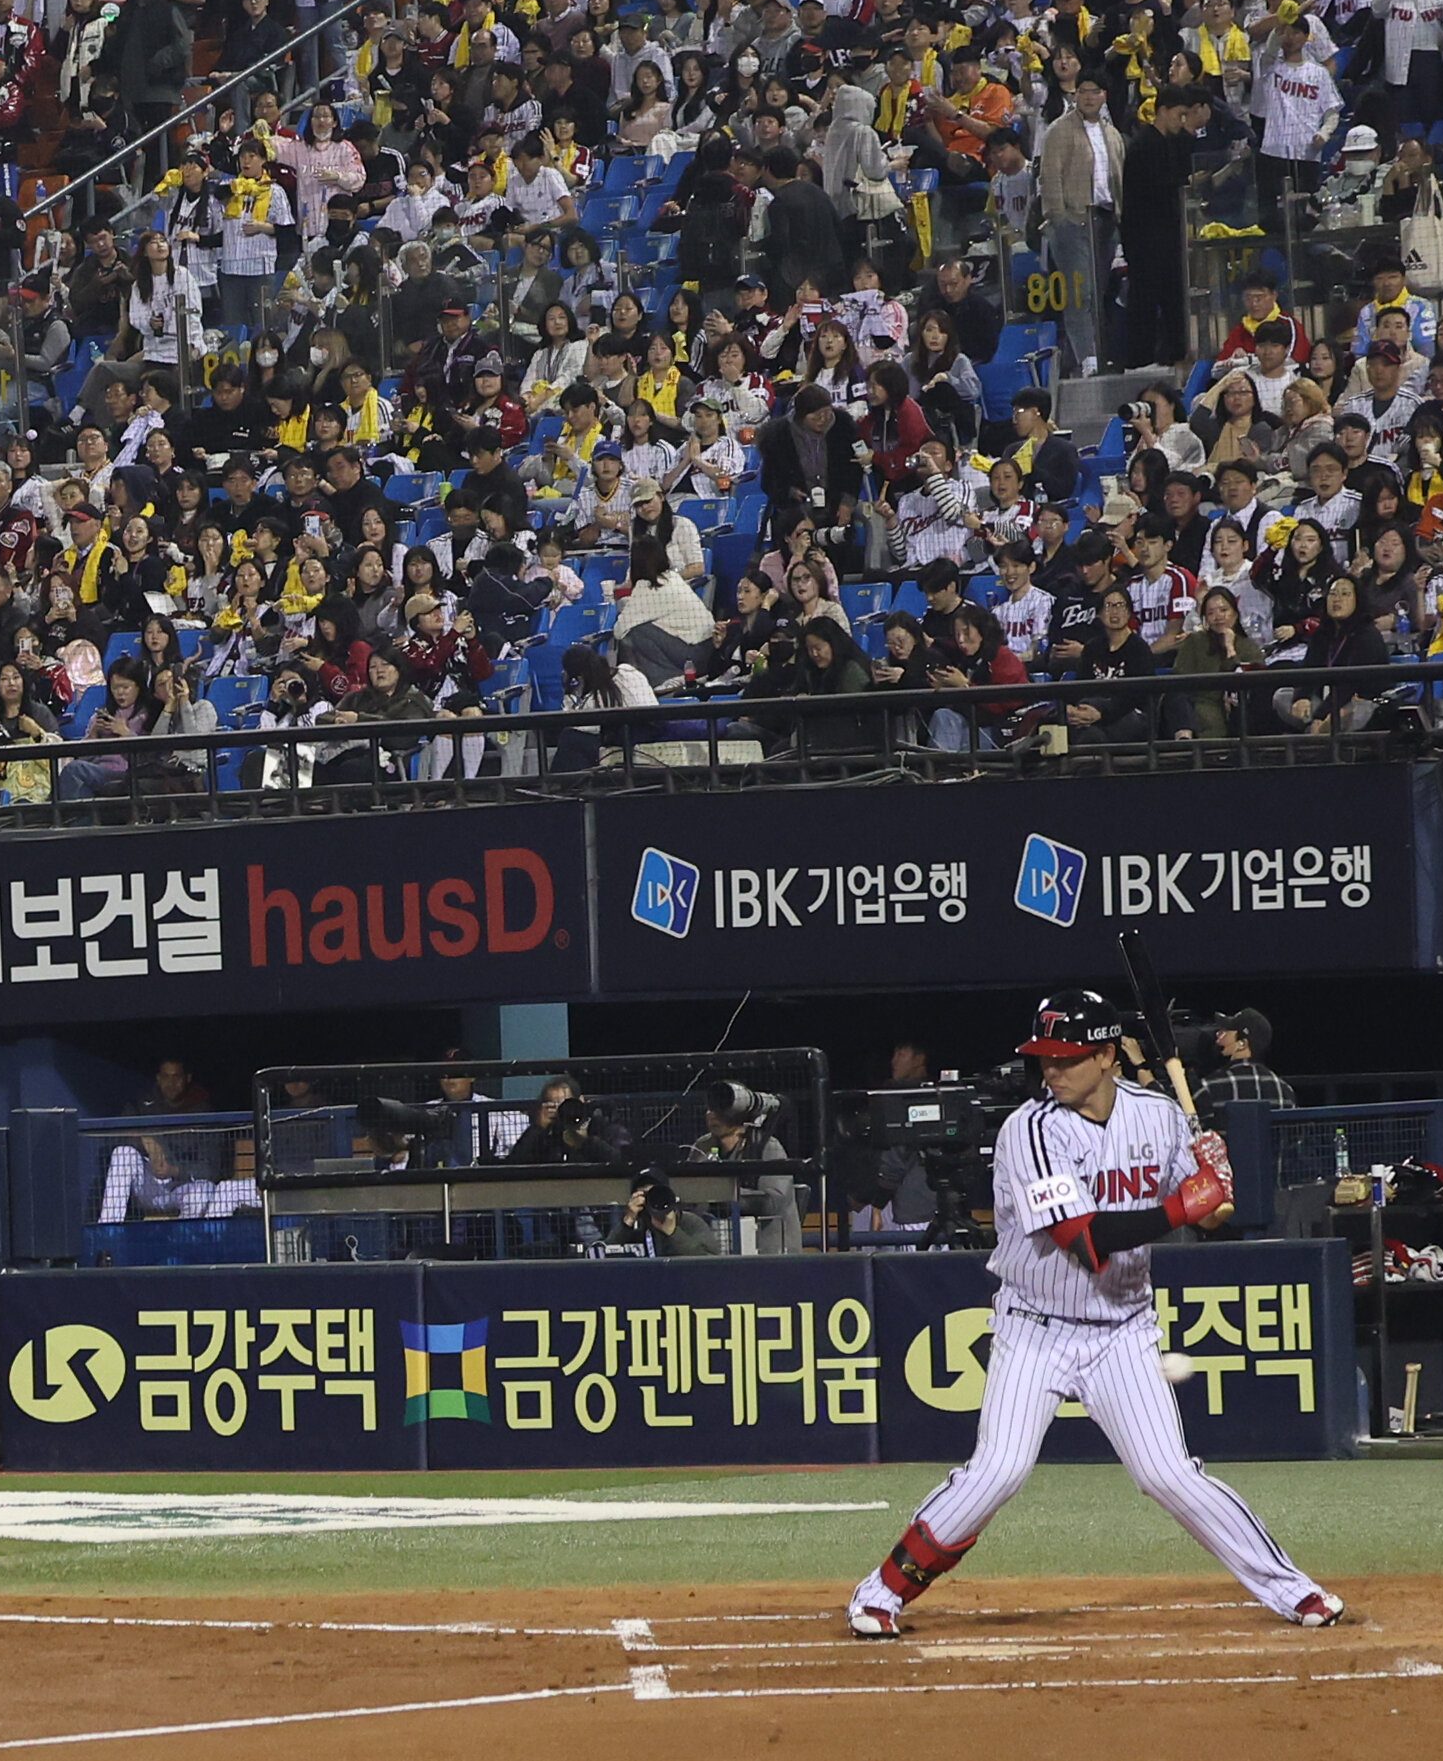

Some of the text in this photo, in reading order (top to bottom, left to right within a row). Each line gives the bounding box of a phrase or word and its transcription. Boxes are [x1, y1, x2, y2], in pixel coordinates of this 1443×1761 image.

[1274, 73, 1319, 100] TWINS
[246, 847, 554, 967] hausD
[714, 859, 969, 929] IBK기업은행
[1101, 844, 1373, 917] IBK기업은행
[1129, 1143, 1154, 1162] LG
[135, 1308, 378, 1437] 금강주택
[494, 1298, 881, 1435] 금강펜테리움
